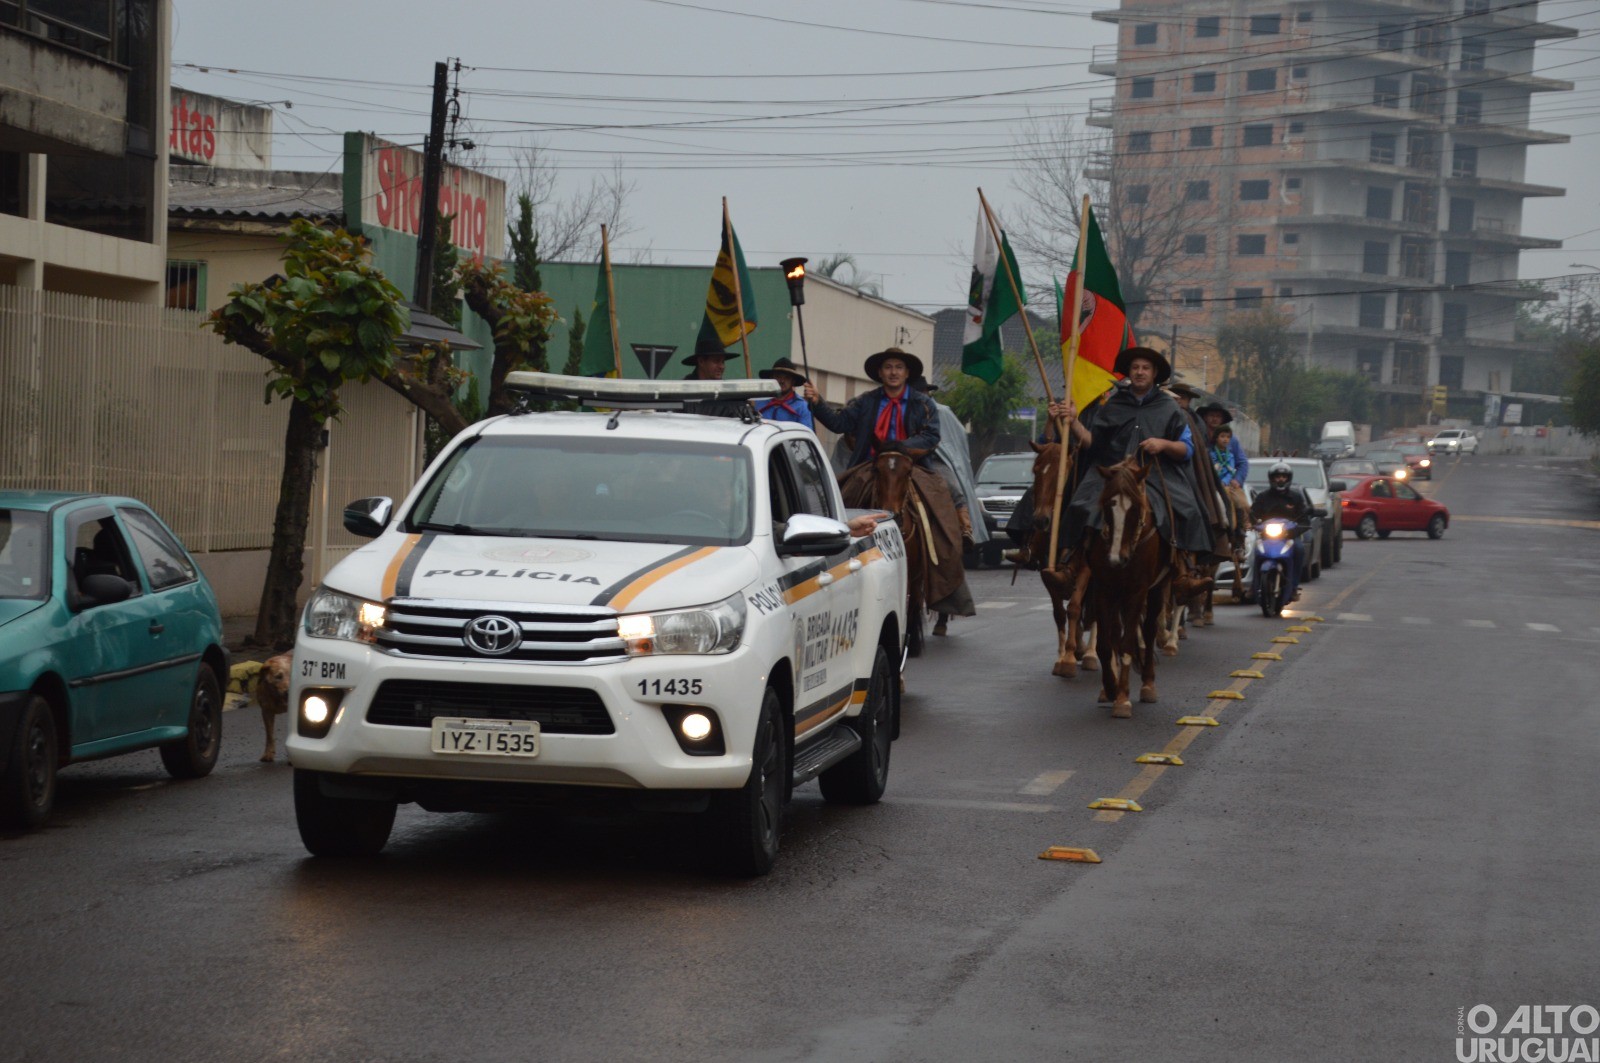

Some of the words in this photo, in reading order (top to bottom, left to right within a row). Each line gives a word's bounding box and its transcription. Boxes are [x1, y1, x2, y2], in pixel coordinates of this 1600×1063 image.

[423, 568, 601, 586] POLÍCIA
[807, 610, 831, 642] BRIGADA
[830, 607, 859, 659] 11435
[804, 638, 828, 670] MILITAR
[321, 661, 346, 680] BPM
[637, 678, 703, 696] 11435
